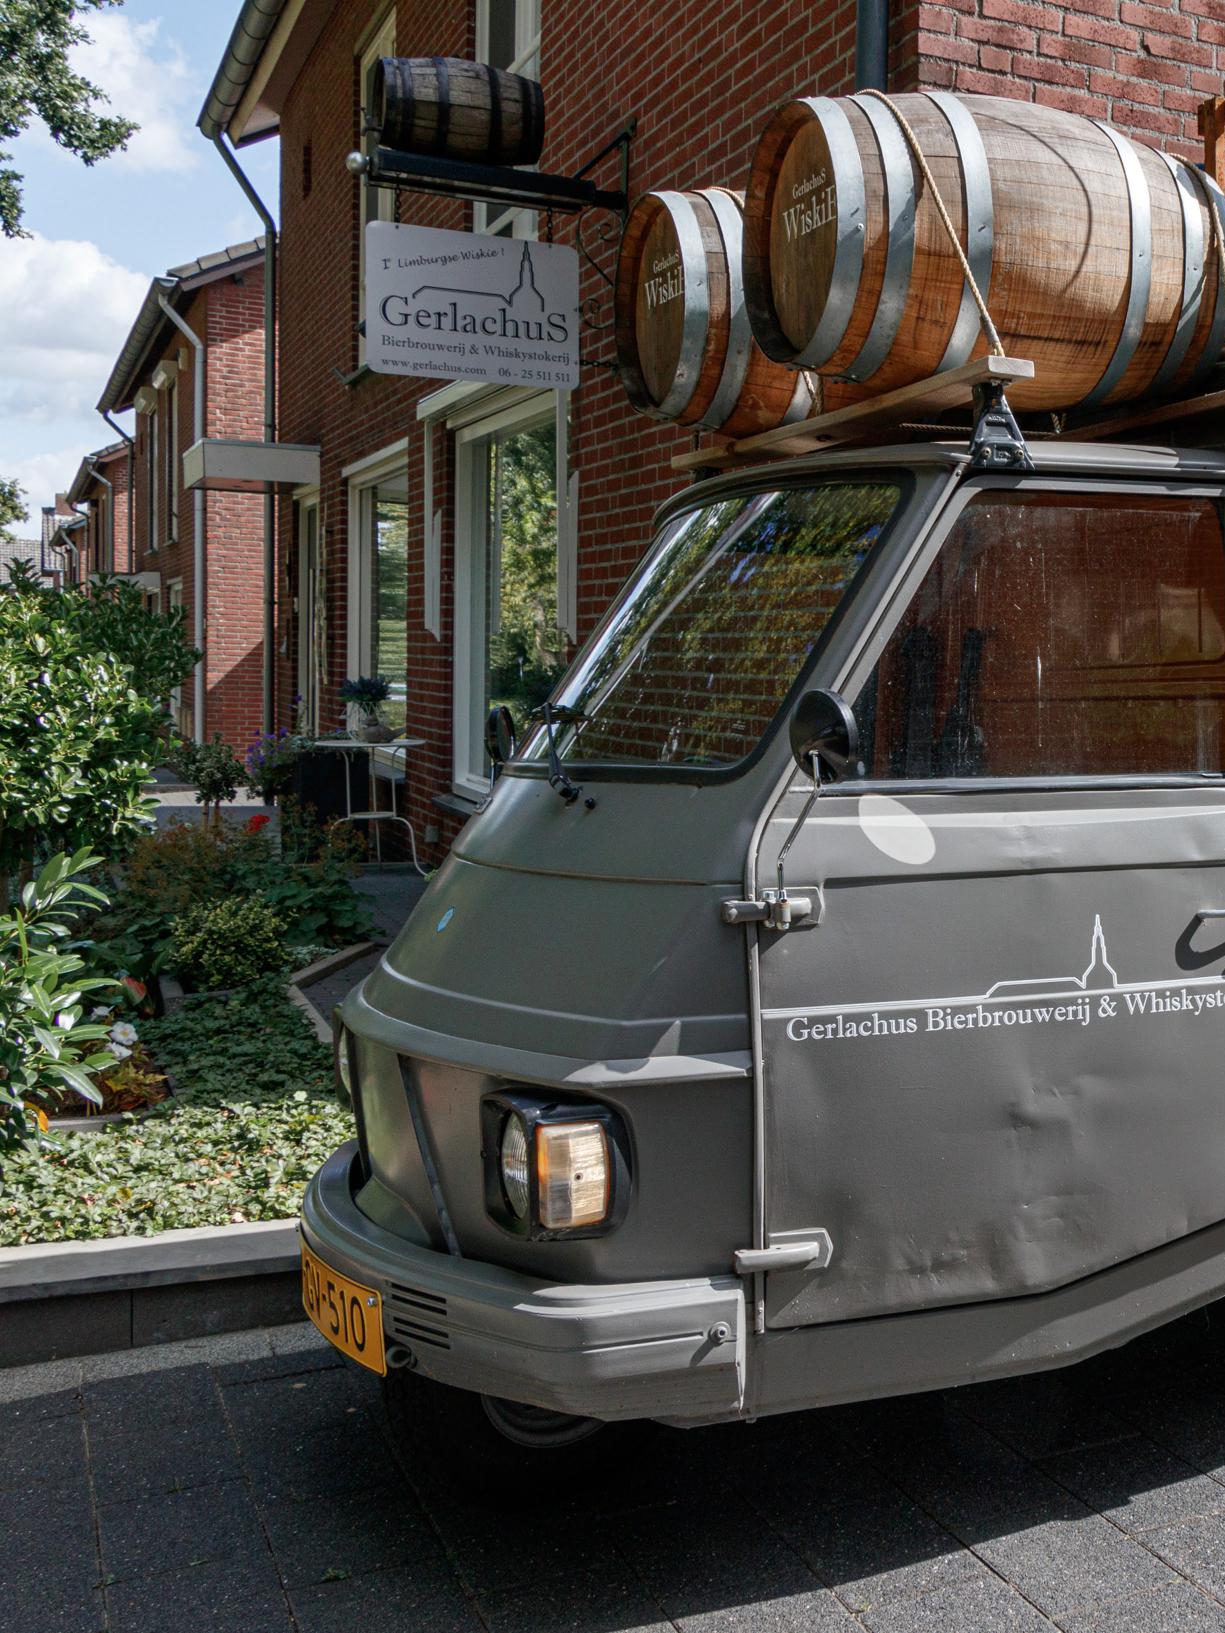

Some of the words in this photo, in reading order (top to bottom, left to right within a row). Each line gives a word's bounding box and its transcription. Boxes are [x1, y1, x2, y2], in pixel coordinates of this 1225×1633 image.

[398, 254, 459, 268] Limburgse
[379, 294, 569, 343] GerlachuS
[381, 334, 466, 356] Bierbrouwerij
[469, 343, 480, 355] &
[483, 345, 570, 366] Whiskystokerij
[381, 358, 487, 376] www.gerlachus.com
[498, 367, 511, 378] 06
[521, 369, 533, 380] 25
[536, 370, 551, 381] 511
[555, 372, 570, 383] 511
[785, 1013, 918, 1043] Gerlachus
[924, 998, 1091, 1033] Bierbrouwerij
[1097, 996, 1118, 1018] &
